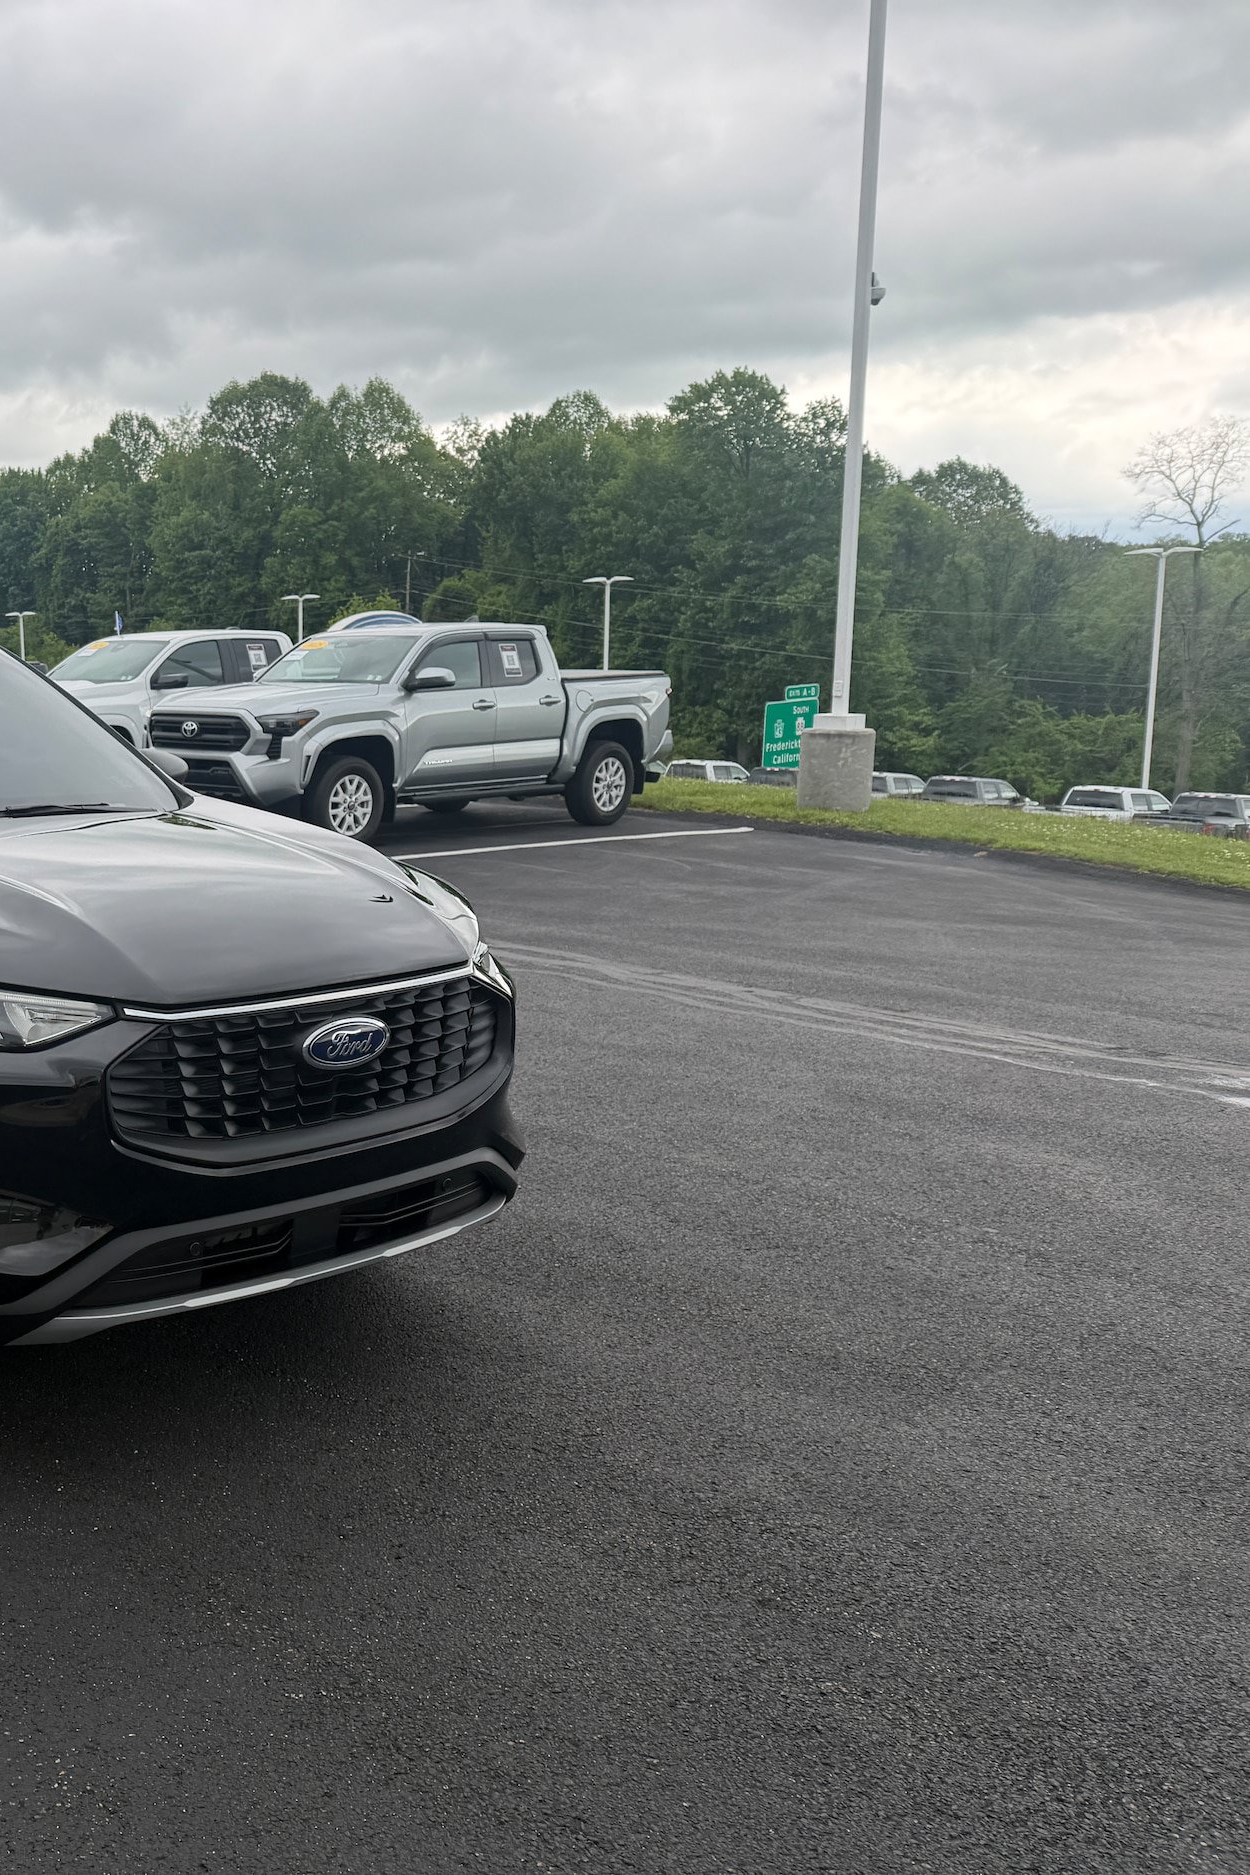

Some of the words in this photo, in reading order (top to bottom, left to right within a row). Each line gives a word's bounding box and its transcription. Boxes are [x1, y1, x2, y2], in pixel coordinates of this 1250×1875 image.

[766, 739, 801, 752] Frederickt
[772, 753, 800, 765] Californ
[326, 1027, 374, 1059] Ford
